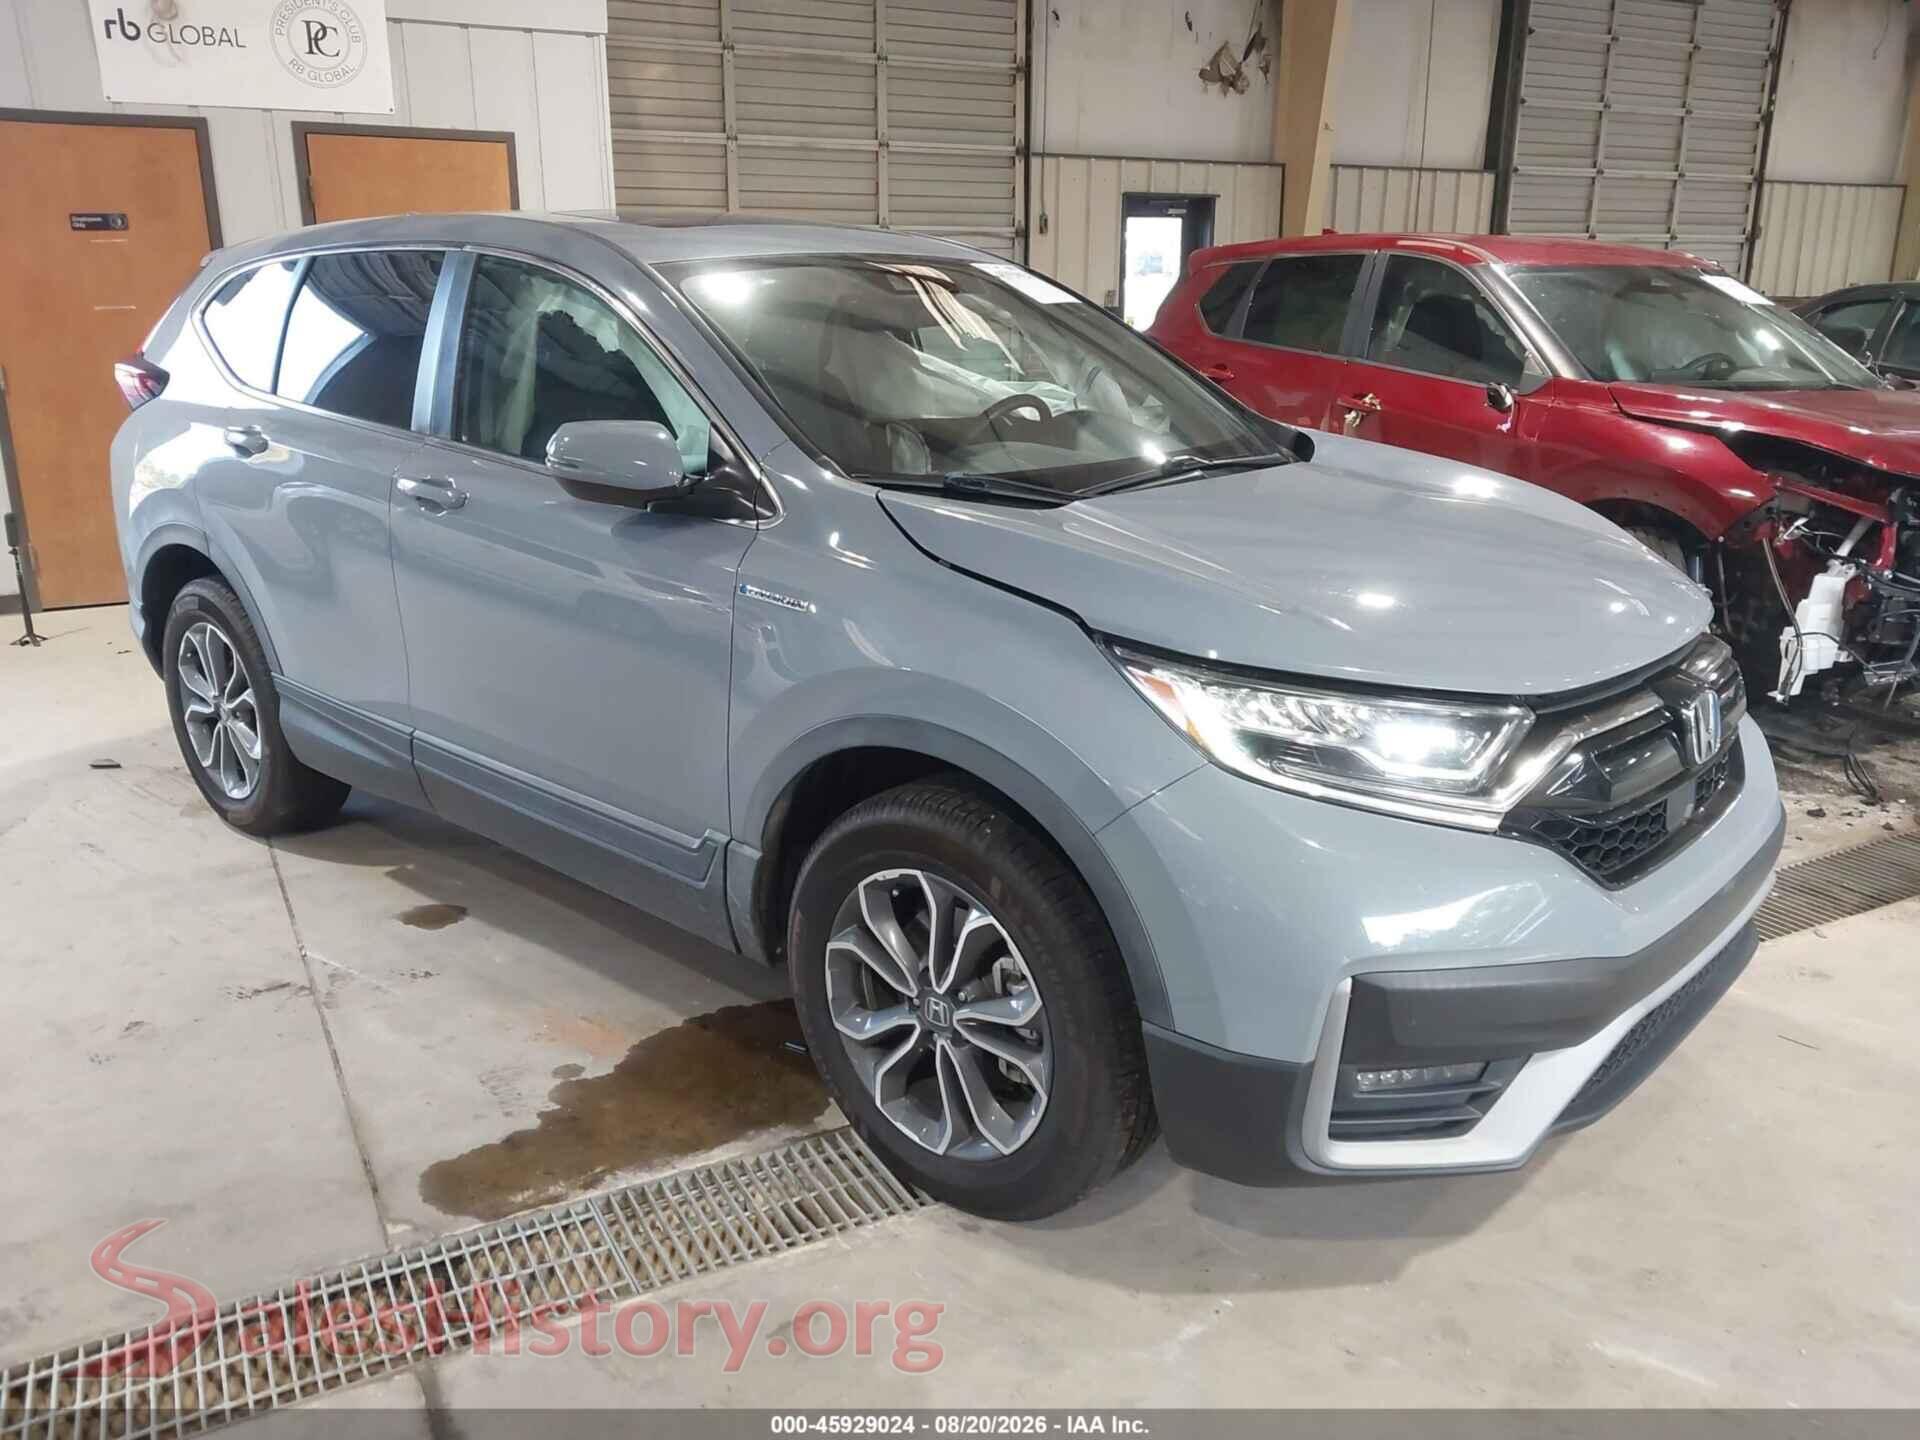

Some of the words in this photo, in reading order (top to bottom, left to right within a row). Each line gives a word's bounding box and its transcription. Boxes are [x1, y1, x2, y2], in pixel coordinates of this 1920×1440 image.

[104, 8, 141, 41] rb
[146, 22, 247, 48] GLOBAL
[301, 20, 341, 57] PC
[340, 9, 361, 43] CLUB
[287, 57, 305, 74] RB
[307, 63, 357, 82] GLOBAL
